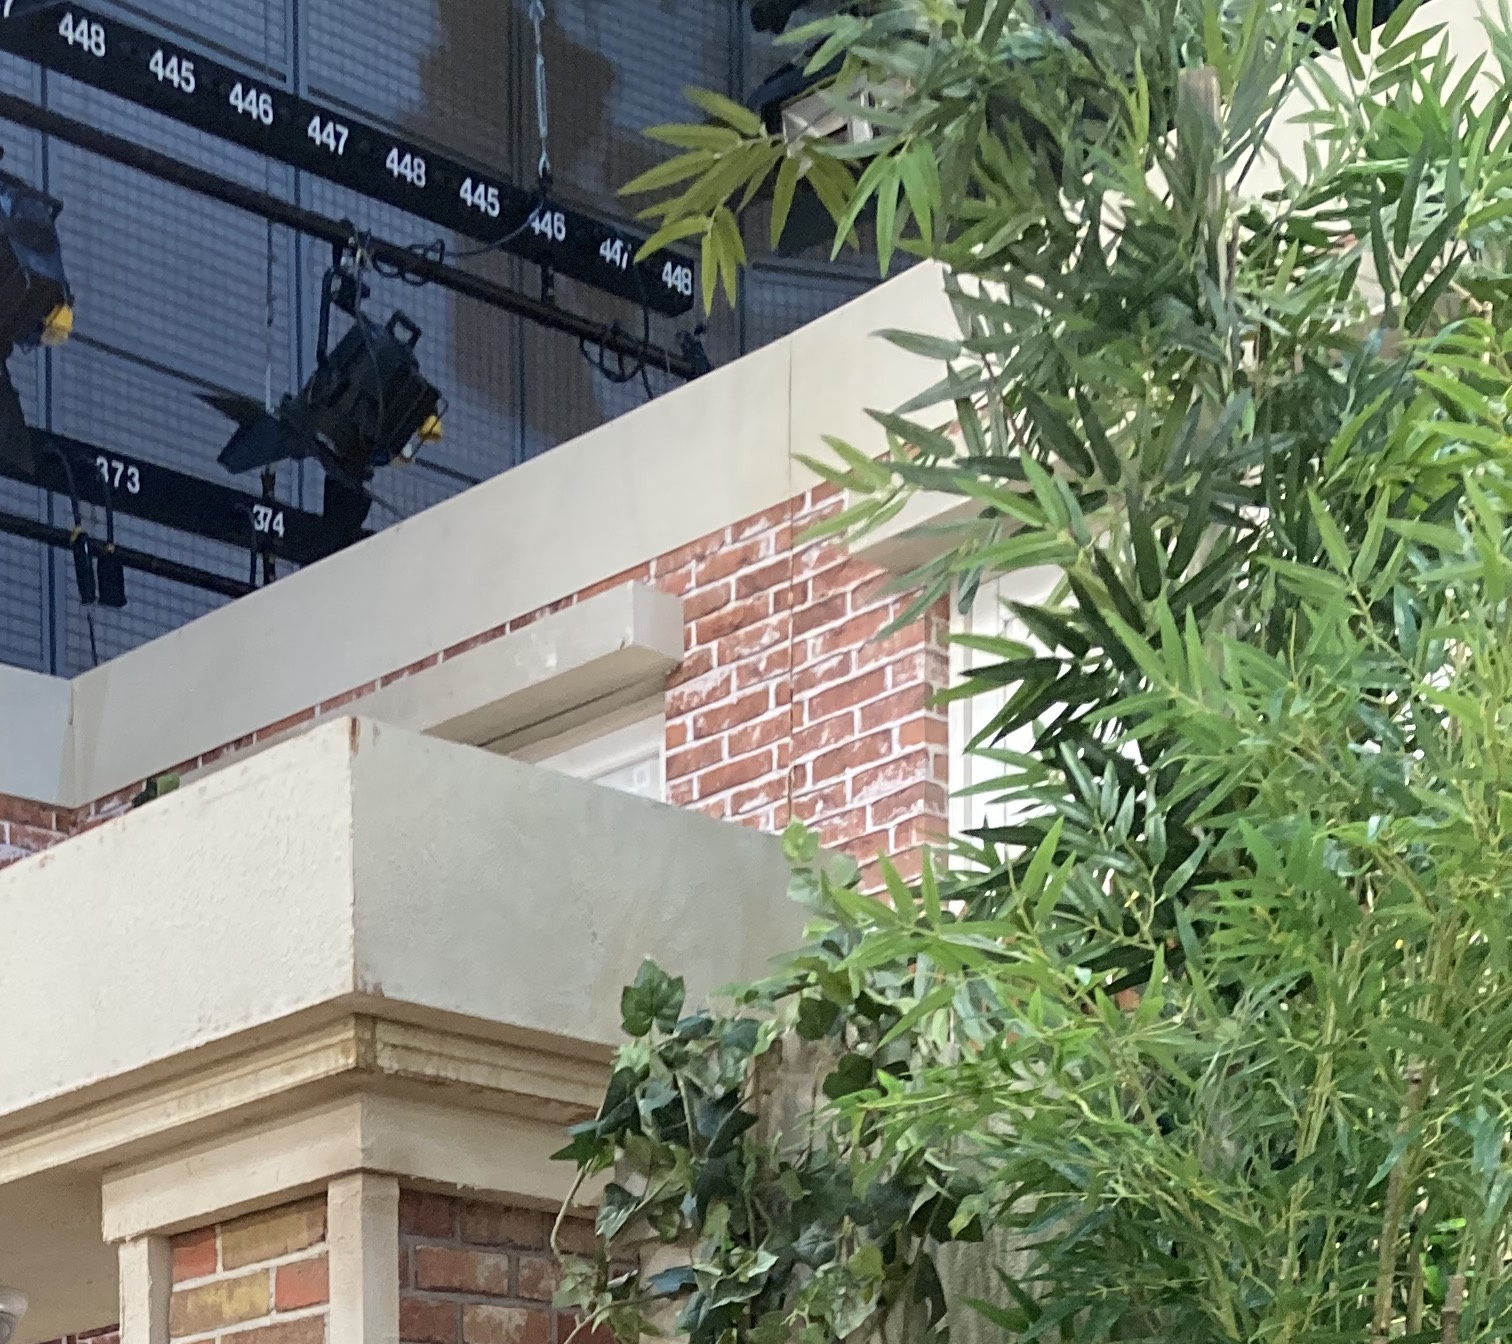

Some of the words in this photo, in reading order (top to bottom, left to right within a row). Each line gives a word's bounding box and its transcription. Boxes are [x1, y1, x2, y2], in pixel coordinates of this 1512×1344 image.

[58, 12, 106, 57] 448
[149, 49, 196, 94] 445
[229, 82, 274, 126] 446
[307, 115, 349, 155] 447
[386, 147, 426, 188] 448
[459, 177, 500, 218] 445
[661, 260, 693, 296] 448
[252, 503, 285, 538] 374
